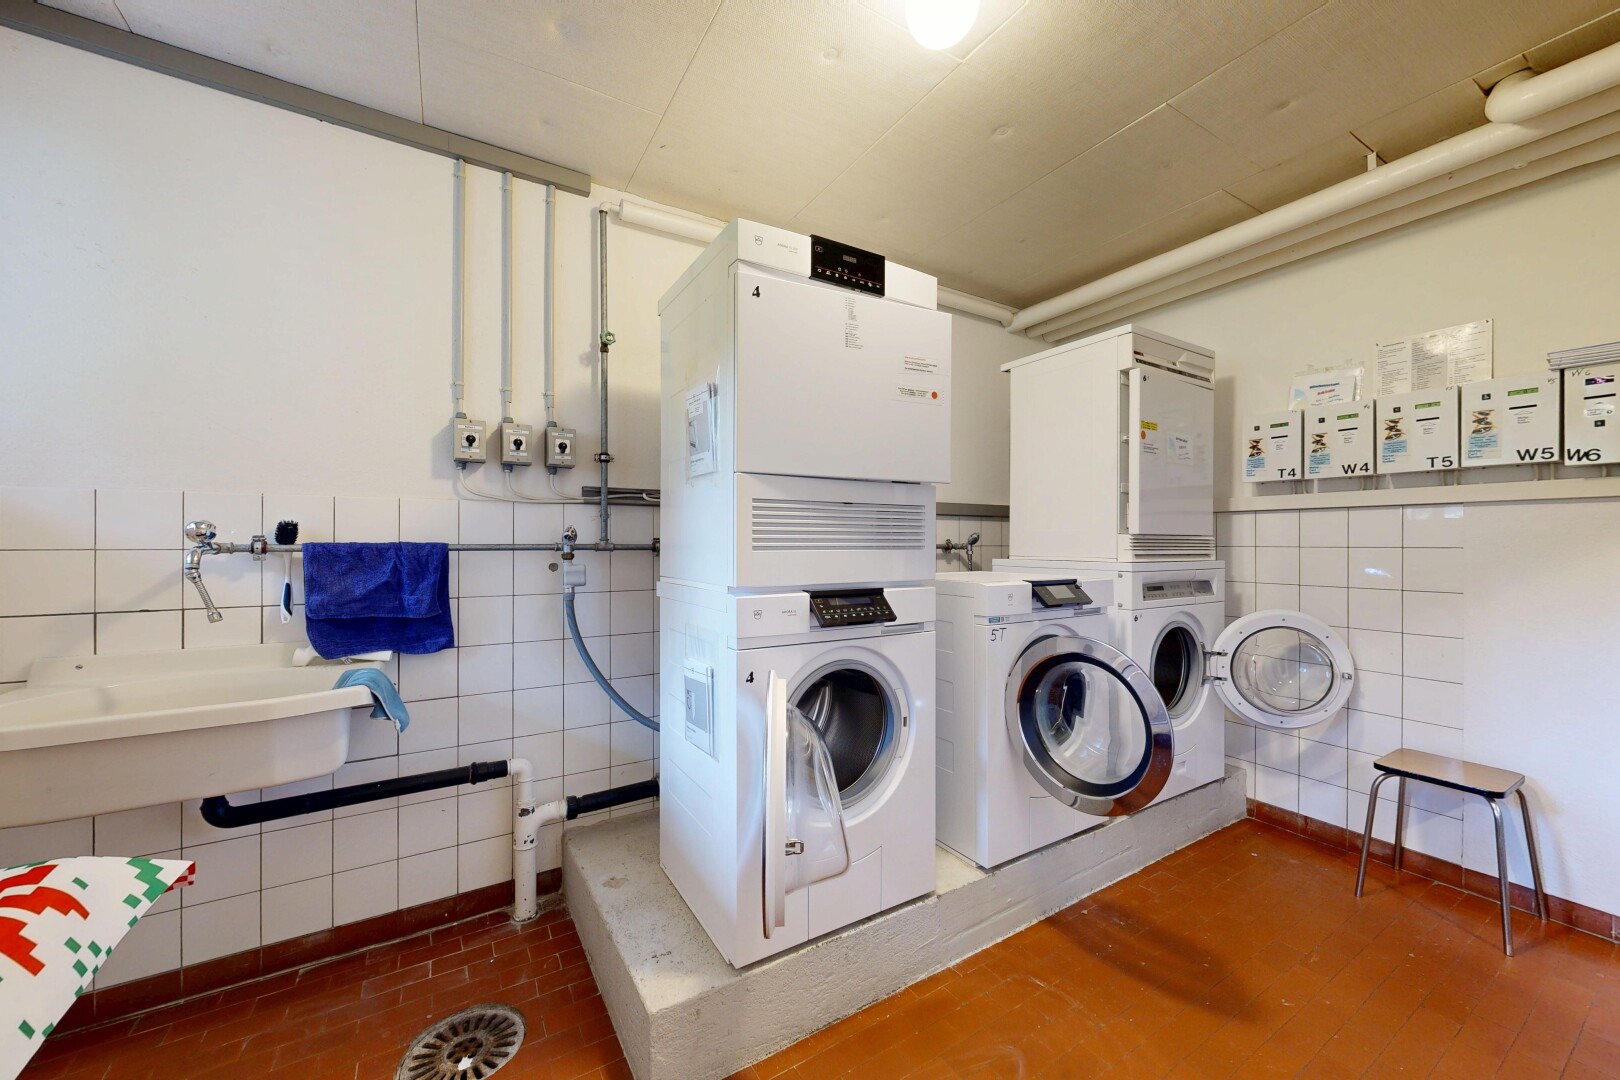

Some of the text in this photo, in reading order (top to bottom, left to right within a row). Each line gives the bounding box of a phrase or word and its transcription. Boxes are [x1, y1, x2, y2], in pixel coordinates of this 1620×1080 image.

[752, 285, 761, 298] 4
[1516, 447, 1555, 461] W5
[1567, 448, 1602, 462] W6
[1426, 455, 1454, 468] T5
[1277, 467, 1297, 479] T4
[1341, 462, 1370, 475] W4
[990, 627, 1007, 642] 5T
[745, 671, 755, 683] 4
